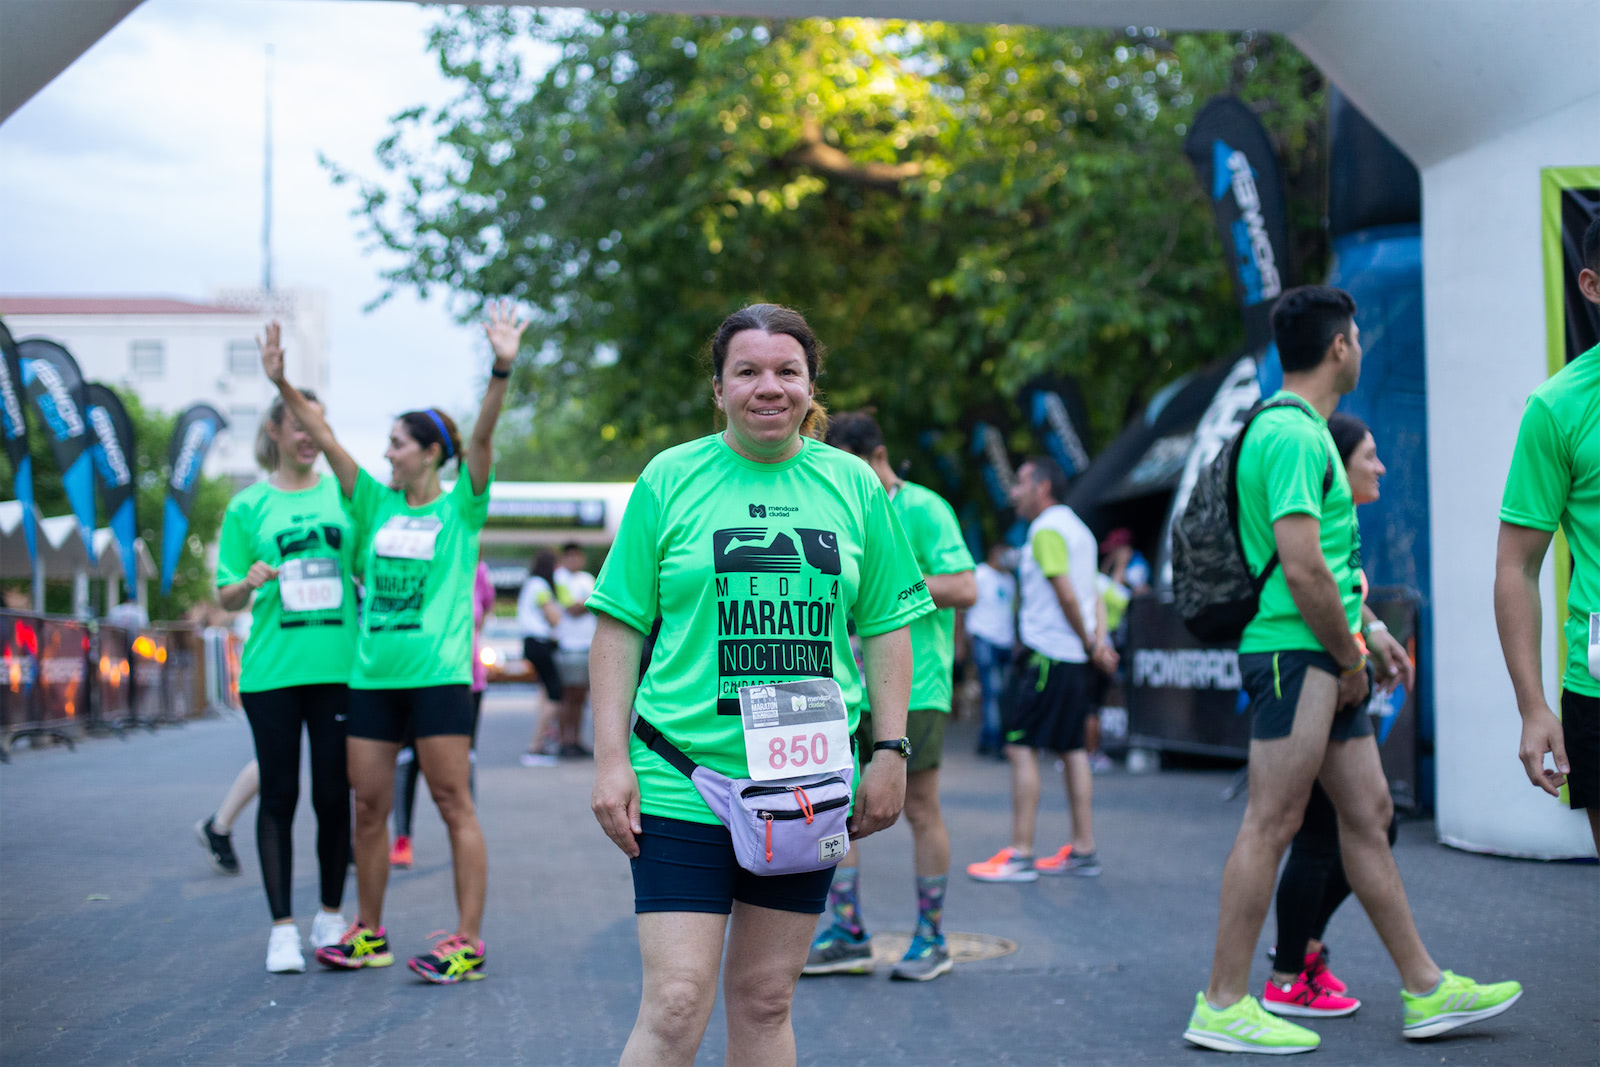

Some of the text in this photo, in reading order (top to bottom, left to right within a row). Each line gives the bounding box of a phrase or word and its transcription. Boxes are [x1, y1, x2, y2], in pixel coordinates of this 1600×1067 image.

[715, 576, 839, 600] MEDIA
[717, 597, 835, 637] MARATÓN
[723, 643, 831, 673] NOCTURNA
[768, 732, 829, 770] 850
